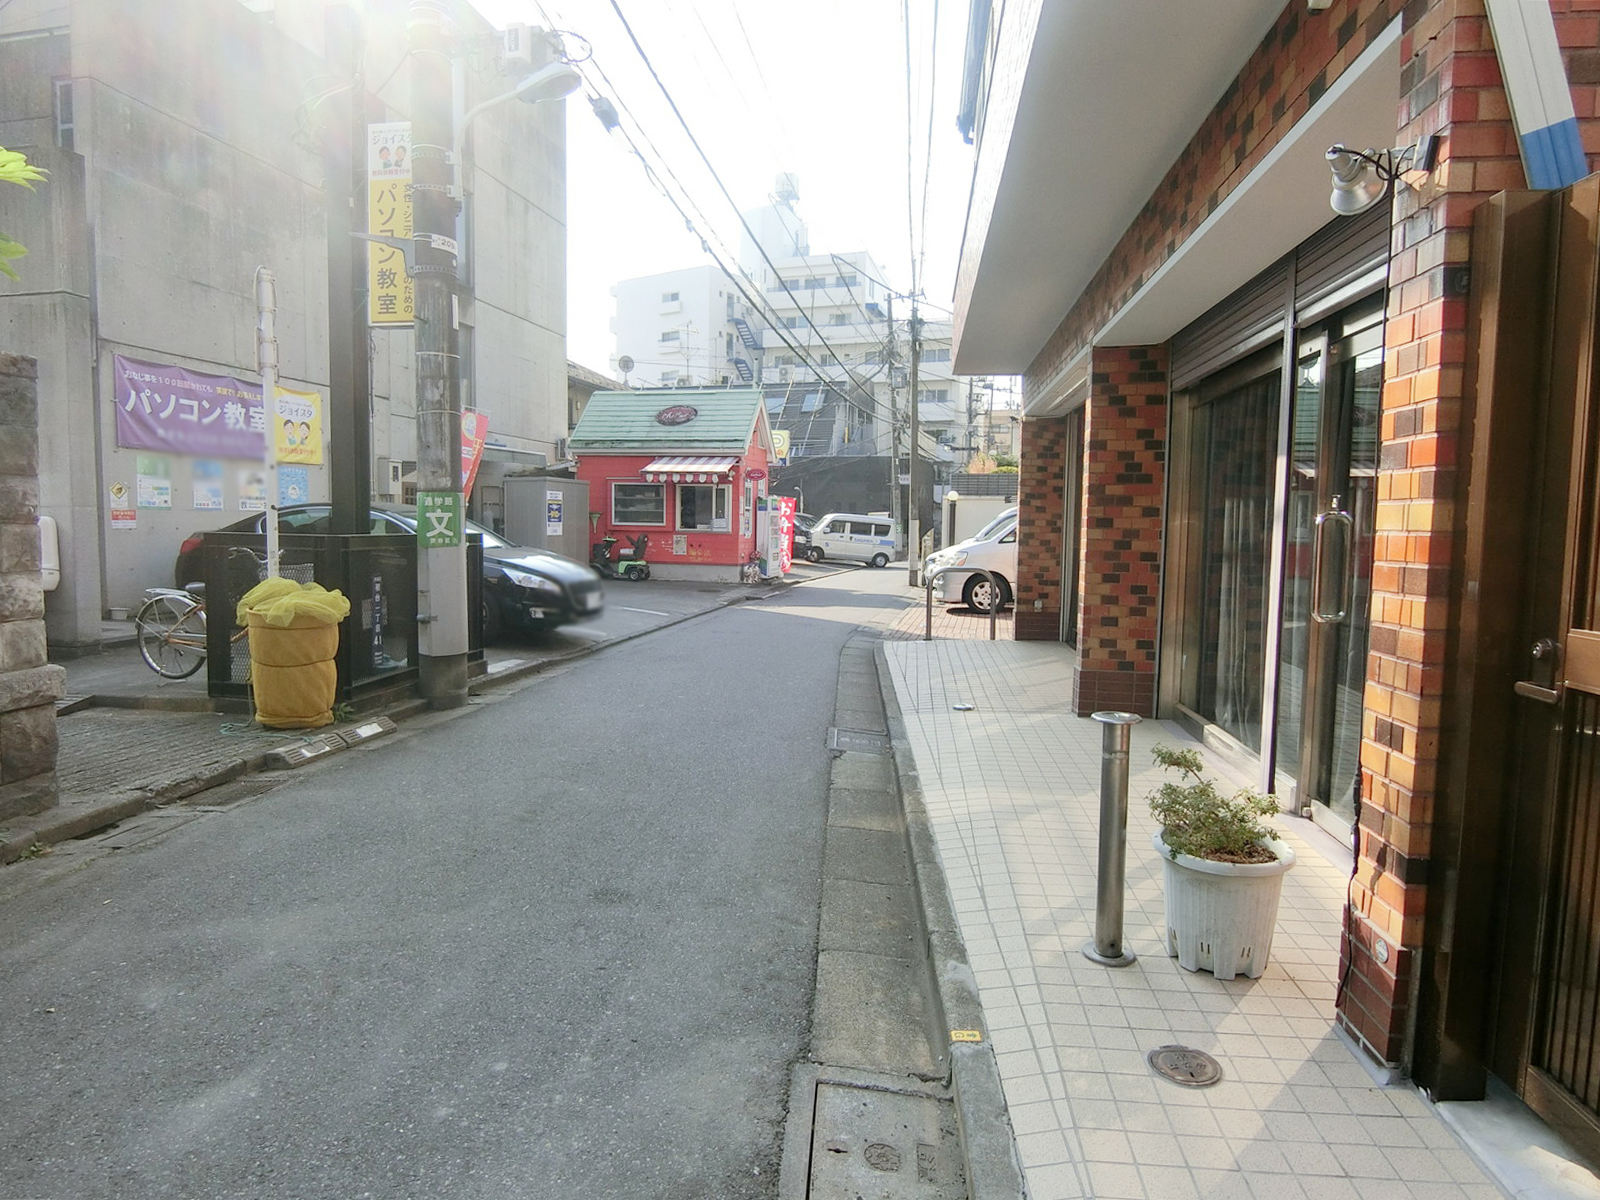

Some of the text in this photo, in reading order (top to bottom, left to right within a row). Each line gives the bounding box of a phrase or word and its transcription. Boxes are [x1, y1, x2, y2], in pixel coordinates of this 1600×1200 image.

[376, 183, 397, 314] パソコン教室
[124, 389, 265, 434] パソコン教室
[279, 404, 313, 418] ジョイスタ
